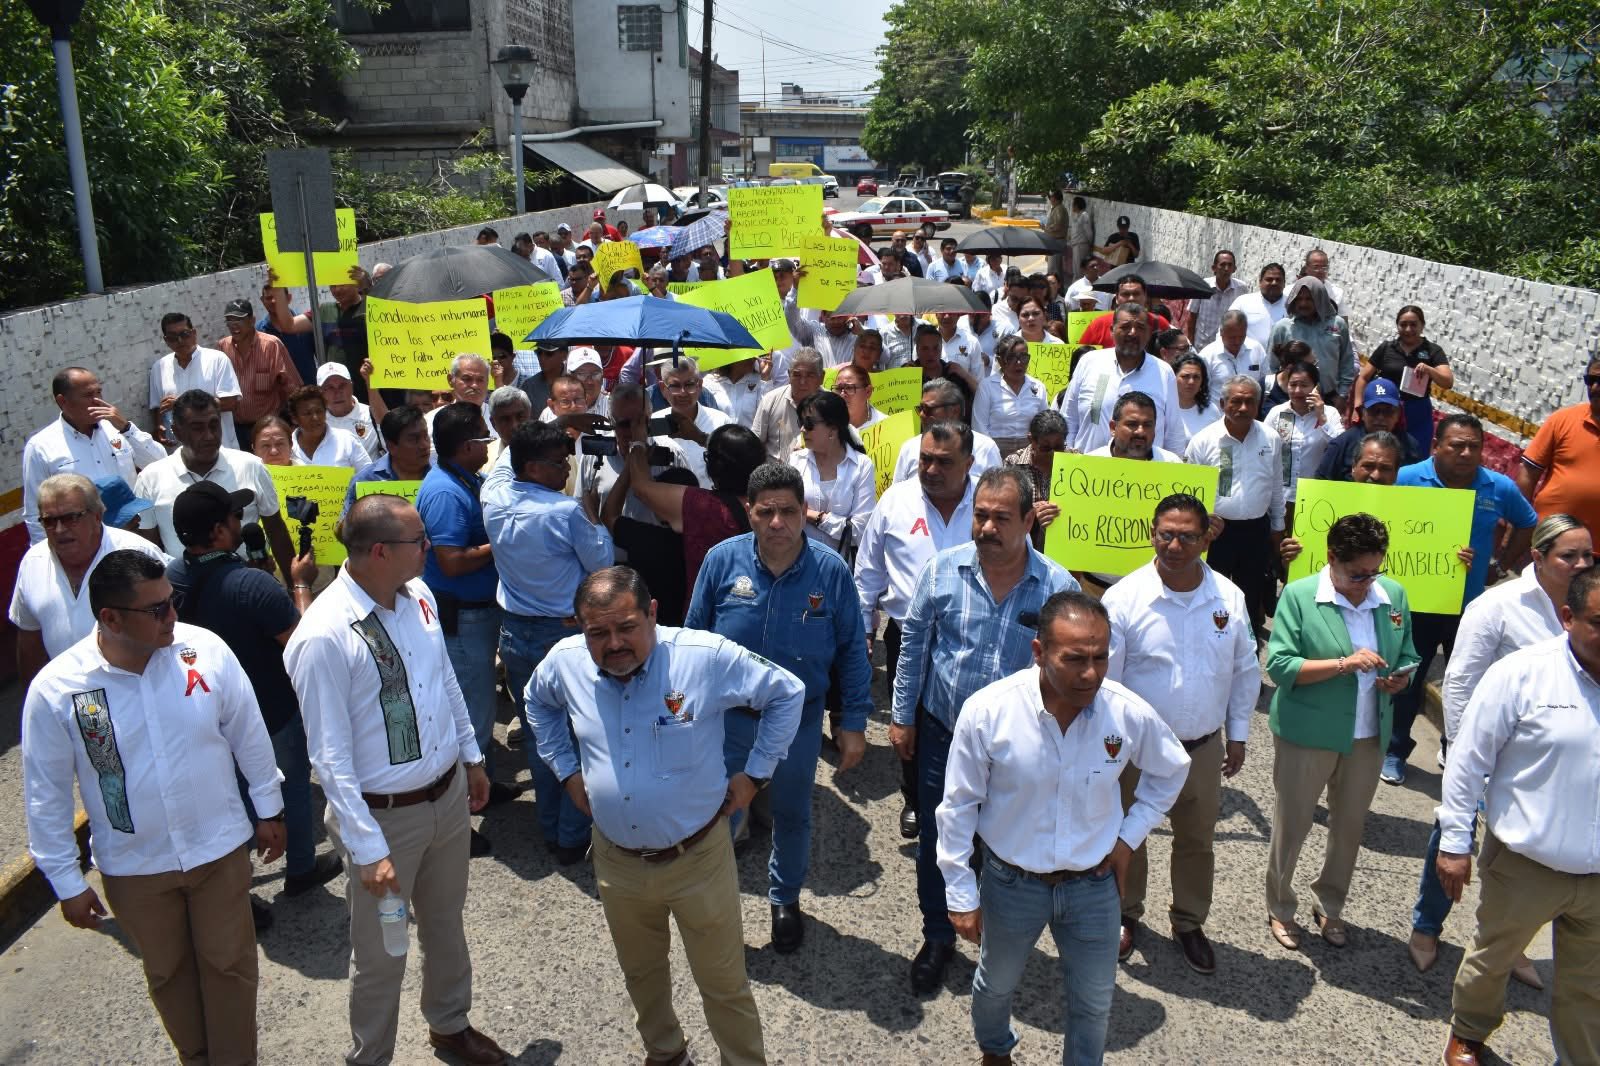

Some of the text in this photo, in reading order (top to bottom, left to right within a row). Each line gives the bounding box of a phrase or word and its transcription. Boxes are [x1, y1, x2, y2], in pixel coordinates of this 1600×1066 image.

[734, 230, 773, 249] ALTO
[373, 328, 479, 347] Para los pacientes
[441, 349, 456, 360] de
[1375, 384, 1386, 396] LA
[1053, 467, 1162, 501] ¿Quiénes
[1068, 514, 1152, 544] los RESPON
[1403, 519, 1434, 535] son
